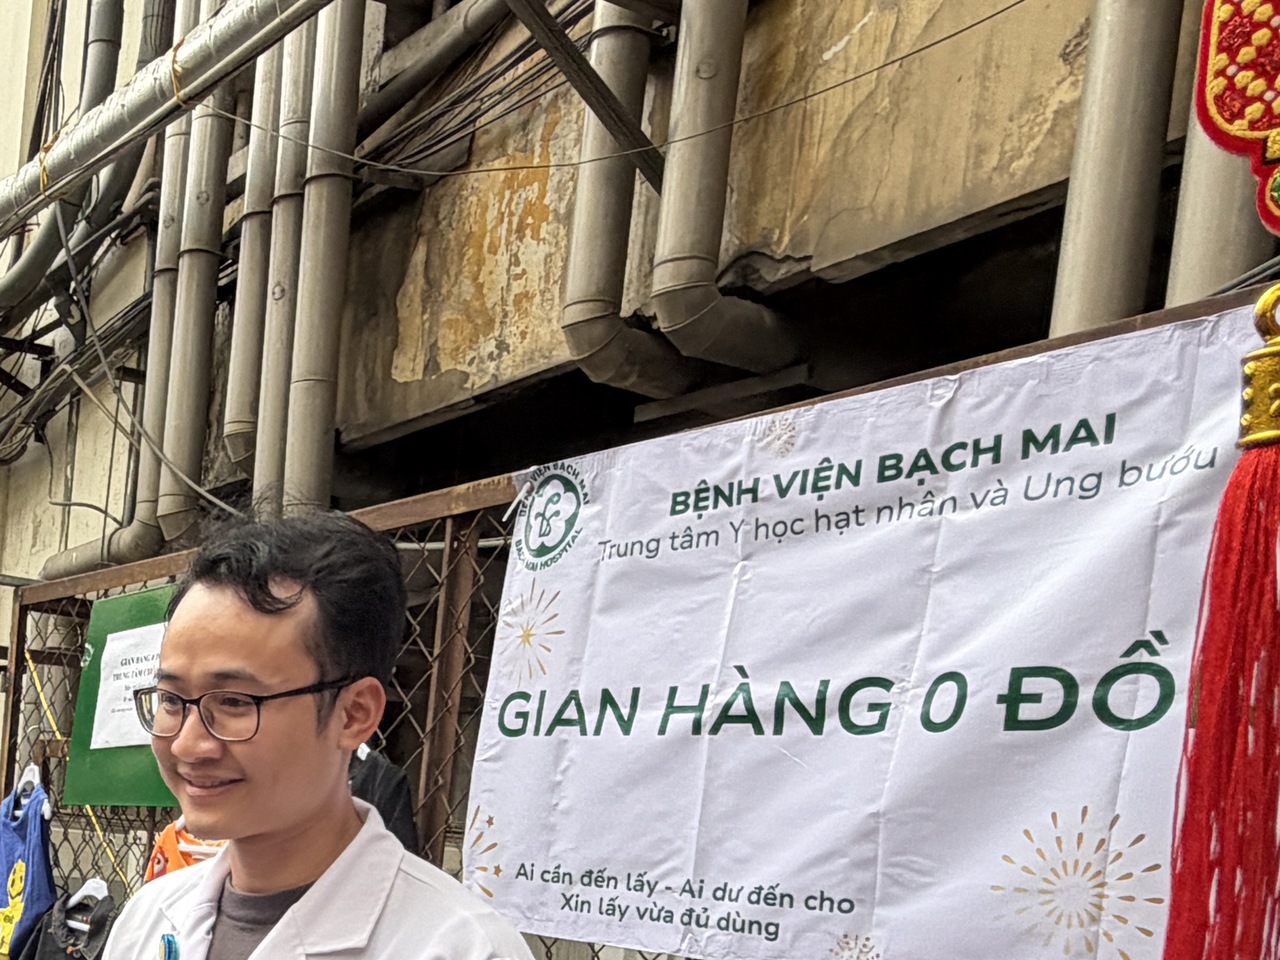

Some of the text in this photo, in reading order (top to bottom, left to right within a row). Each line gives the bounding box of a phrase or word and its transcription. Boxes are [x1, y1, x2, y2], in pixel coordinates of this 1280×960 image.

[598, 445, 1219, 562] Trung tâm Y học hạt nhân và Ung bướu
[670, 412, 1117, 520] BỆNH VIỆN BẠCH MAI
[539, 527, 583, 571] HOSPITAL
[497, 630, 1176, 738] GIAN HÀNG 0 ĐỒ
[515, 862, 535, 881] Ai
[580, 868, 618, 890] đến
[626, 871, 659, 898] lấy
[679, 878, 705, 899] Ai
[712, 882, 744, 903] dư
[747, 883, 794, 908] đến
[804, 890, 855, 914] cho
[561, 893, 780, 942] Xin lấy vừa đủ dùng
